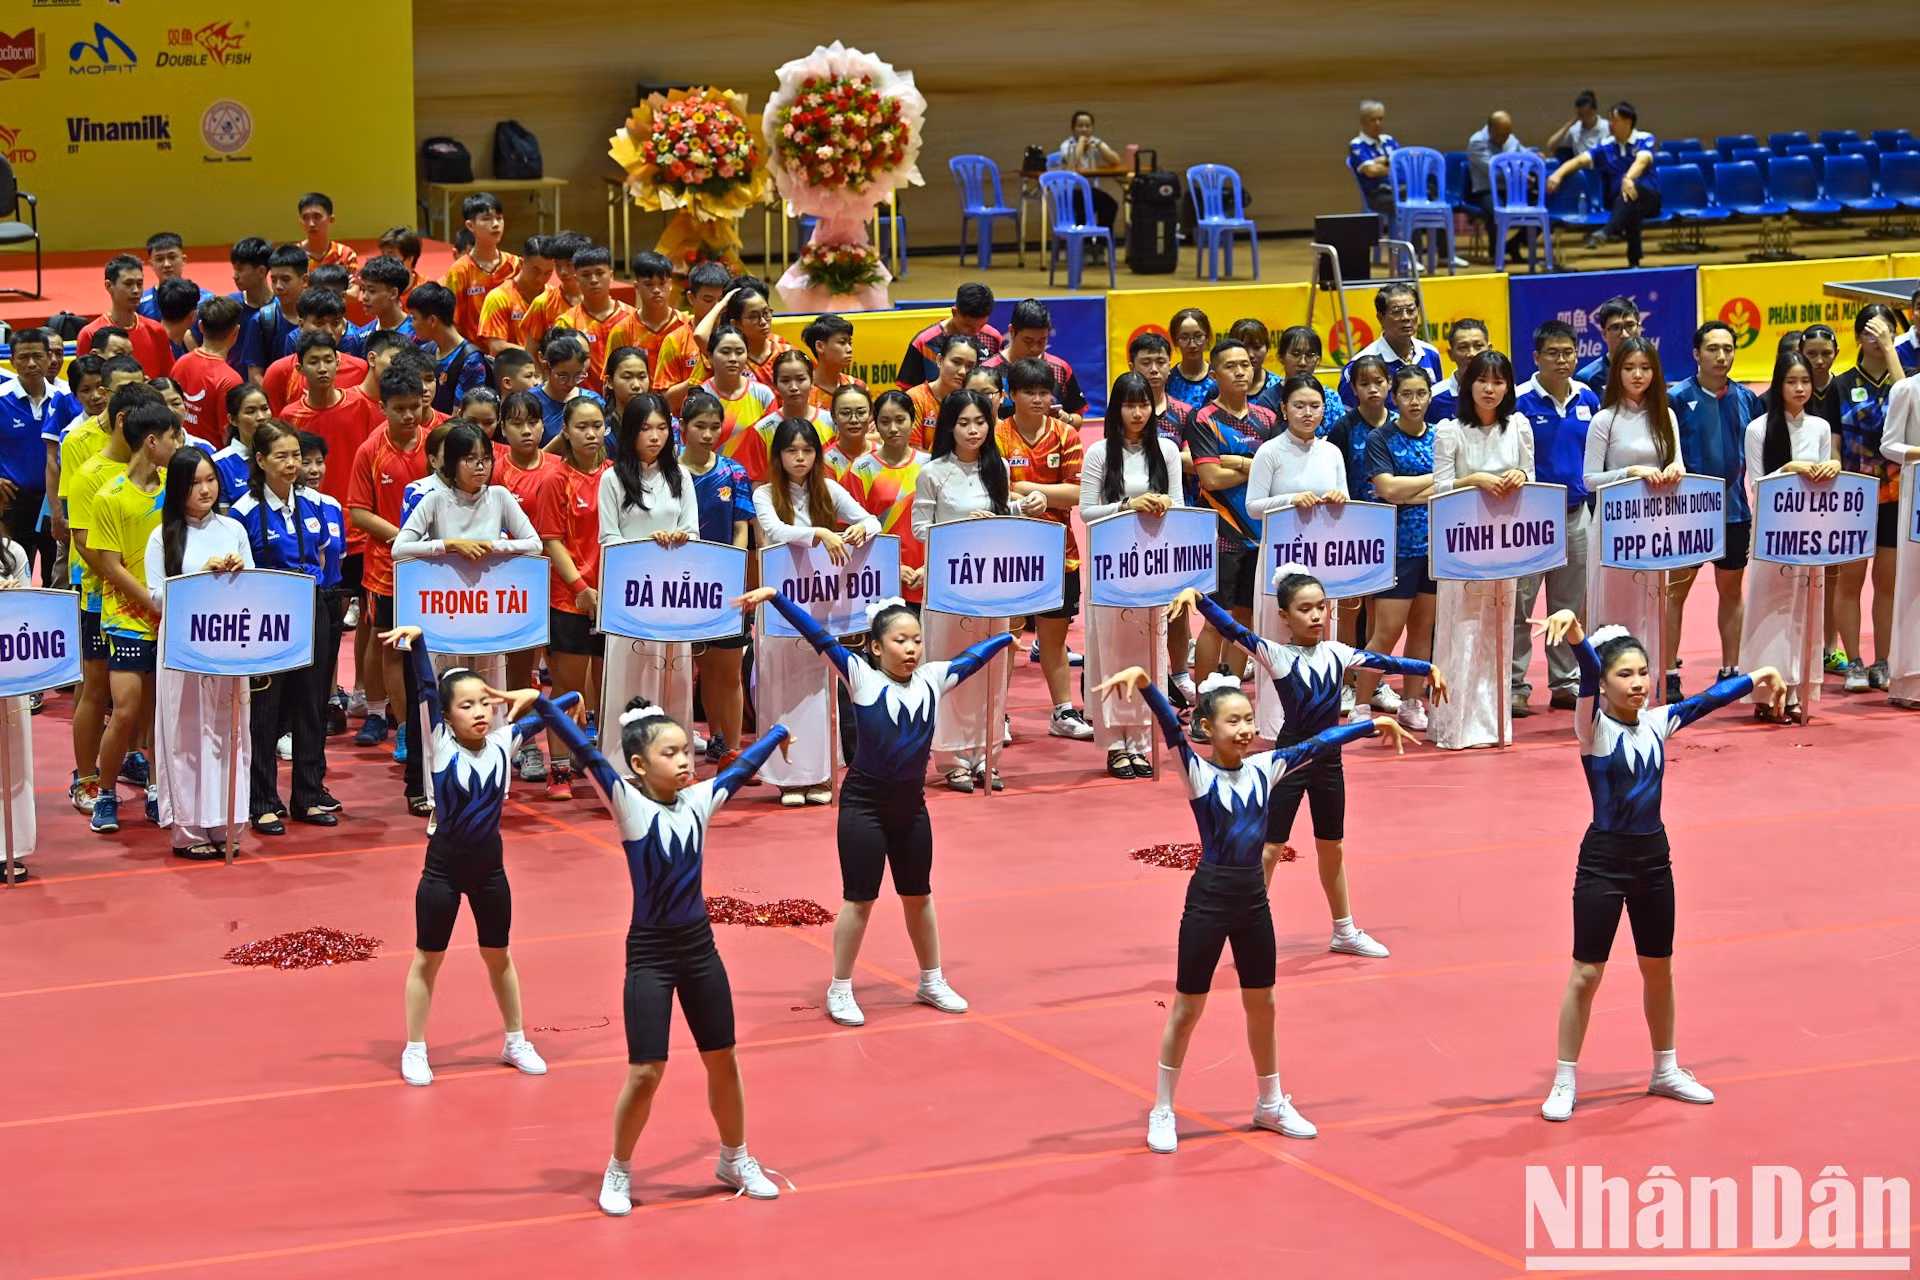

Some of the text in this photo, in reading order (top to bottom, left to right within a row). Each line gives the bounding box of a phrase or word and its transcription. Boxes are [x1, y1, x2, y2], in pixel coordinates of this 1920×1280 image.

[69, 64, 137, 75] MOFIT
[156, 52, 252, 67] DOUBLE FISH
[67, 115, 170, 142] Vinamilk
[1768, 303, 1797, 325] PHÂN
[1800, 301, 1822, 323] BÓN
[1825, 300, 1839, 321] CÀ
[1578, 339, 1602, 358] ble
[872, 360, 897, 384] BÓN
[1605, 491, 1722, 524] CLB ĐẠI HỌC BÌNH DƯƠNG
[1773, 487, 1865, 517] CÂU LẠC BỘ
[1273, 534, 1385, 568] TIỀN GIANG
[1445, 520, 1555, 553] VĨNH LONG
[1614, 526, 1713, 561] PPP CÀ MAU
[1765, 530, 1868, 556] TIMES CITY
[948, 552, 1044, 584] TÂY NINH
[1094, 542, 1213, 581] TP. HỒ CHÍ MINH
[625, 571, 723, 609] ĐÀ NẴNG
[782, 565, 881, 604] QUÂN ĐỘI
[418, 584, 528, 620] TRỌNG TÀI
[0, 622, 66, 662] ĐỒNG
[190, 608, 290, 648] NGHỆ AN
